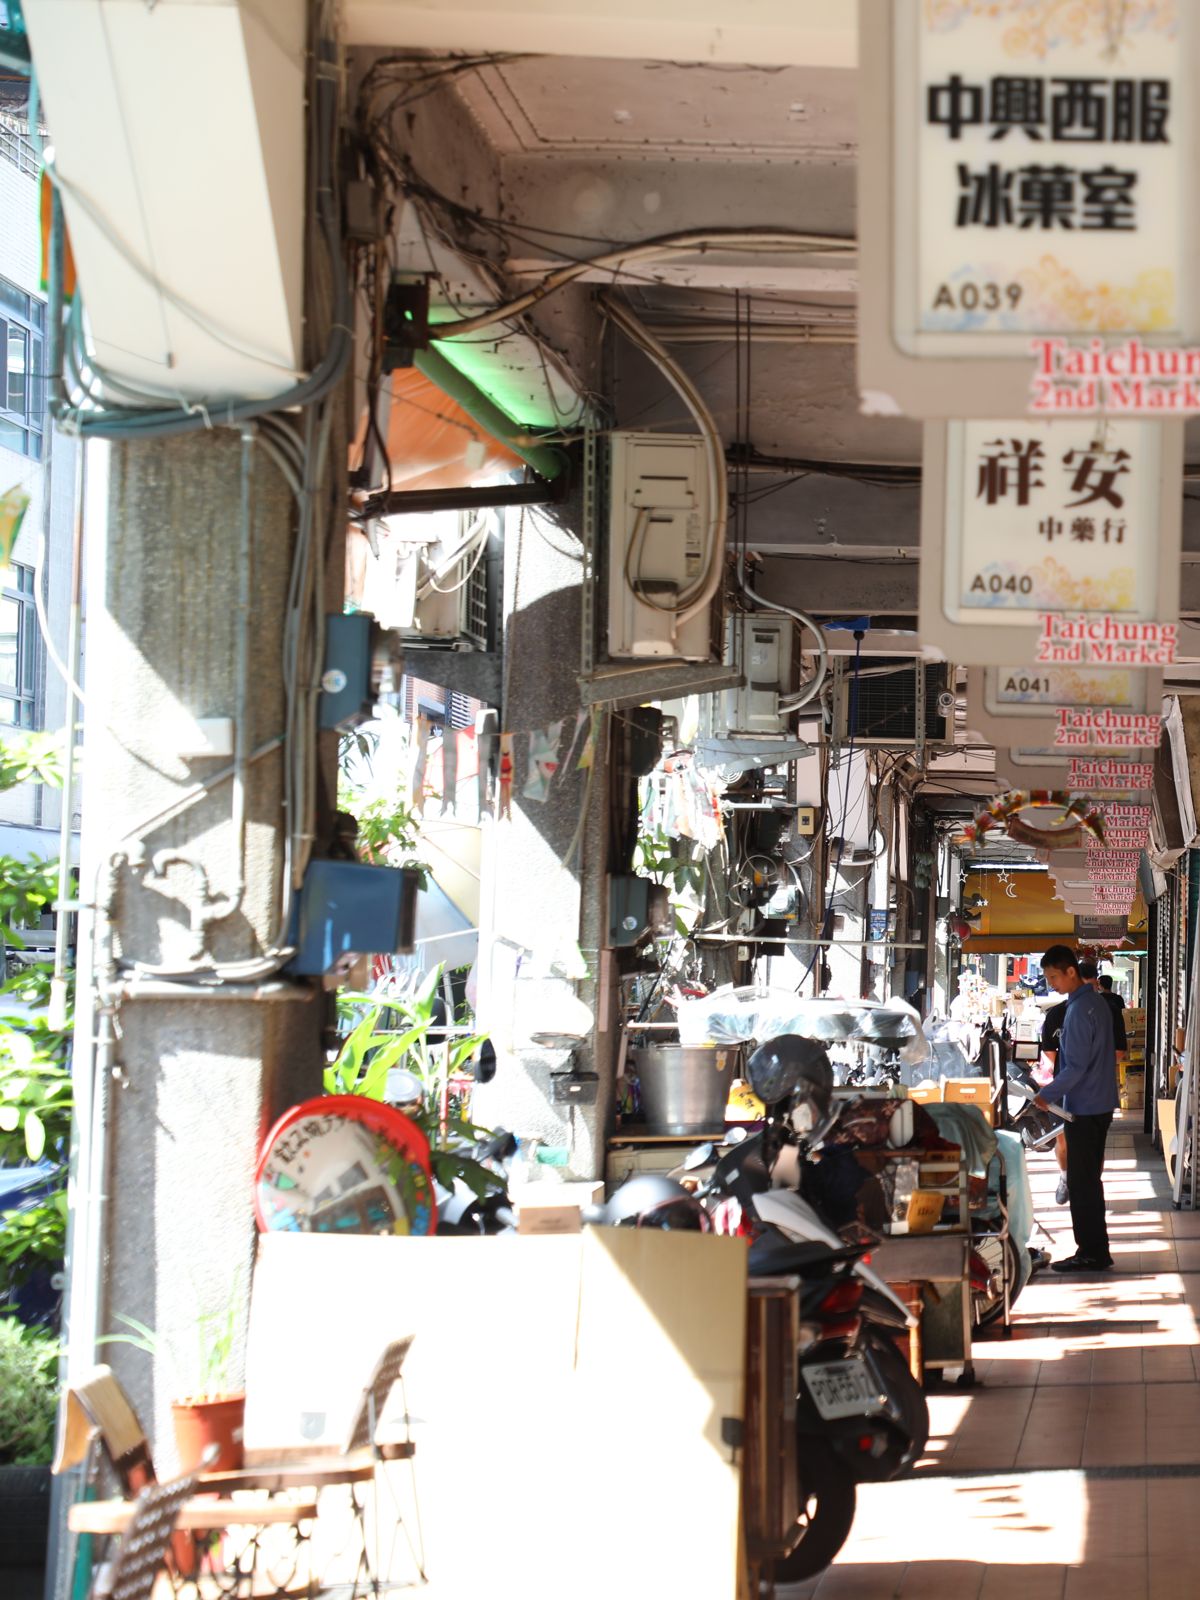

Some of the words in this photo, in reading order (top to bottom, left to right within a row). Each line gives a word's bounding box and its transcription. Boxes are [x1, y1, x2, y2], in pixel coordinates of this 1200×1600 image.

[927, 75, 1170, 144] 中興西服
[955, 163, 1138, 231] 冰菓室
[932, 283, 1023, 311] A039
[1032, 382, 1095, 410] 2nd
[977, 438, 1131, 509] 祥安
[1039, 517, 1127, 544] 中藥行
[971, 575, 1033, 594] A040
[1039, 615, 1176, 647] Taichung
[1039, 642, 1081, 661] 2nd
[1089, 643, 1175, 663] Market
[1004, 677, 1049, 693] A041
[1056, 708, 1160, 733] Taichung
[1056, 729, 1088, 744] 2nd
[1095, 730, 1160, 745] Market
[1068, 758, 1152, 778] Taichung
[1068, 775, 1095, 787] 2nd
[1100, 776, 1152, 788] Market
[1105, 816, 1150, 827] Market
[1110, 838, 1147, 848] Market
[1106, 859, 1139, 868] Market
